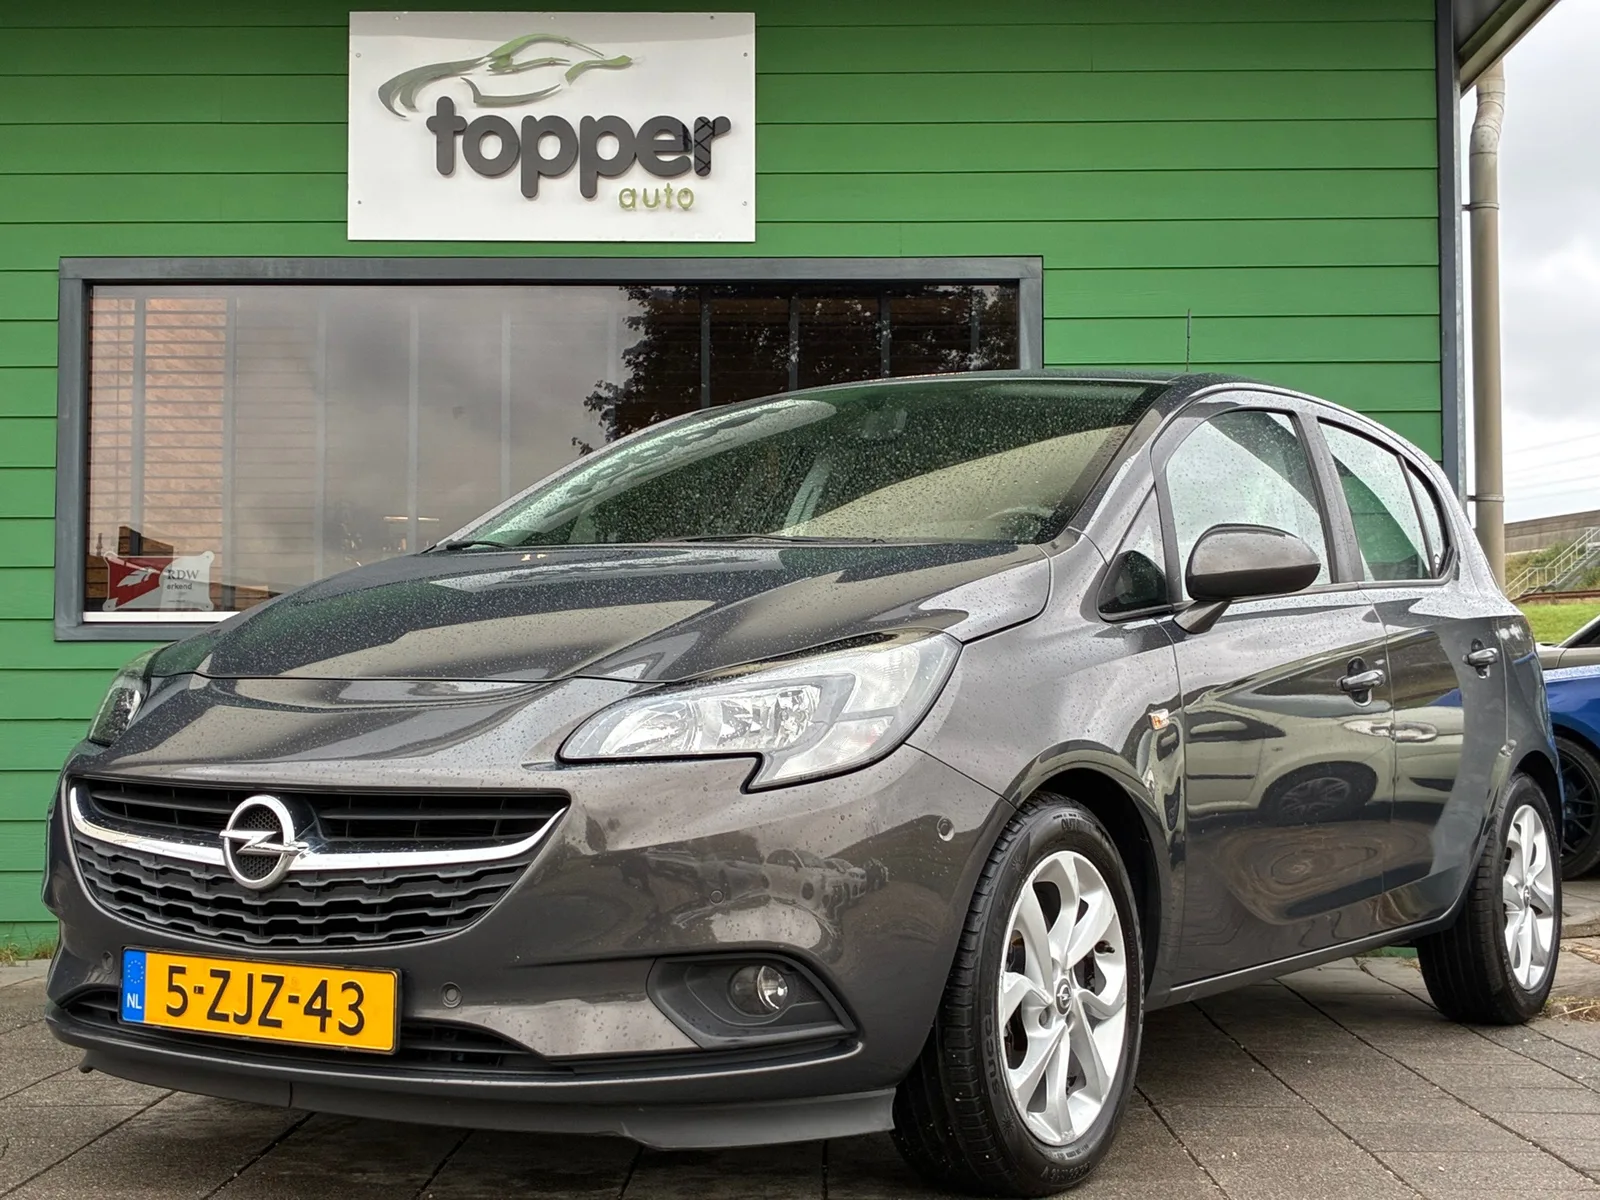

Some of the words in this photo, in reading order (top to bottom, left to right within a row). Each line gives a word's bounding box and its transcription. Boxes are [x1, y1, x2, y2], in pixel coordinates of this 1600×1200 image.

[426, 96, 731, 199] topper
[619, 182, 694, 210] auto
[167, 569, 199, 580] RDW
[126, 992, 142, 1010] NL
[165, 964, 365, 1036] 5-ZJZ-43
